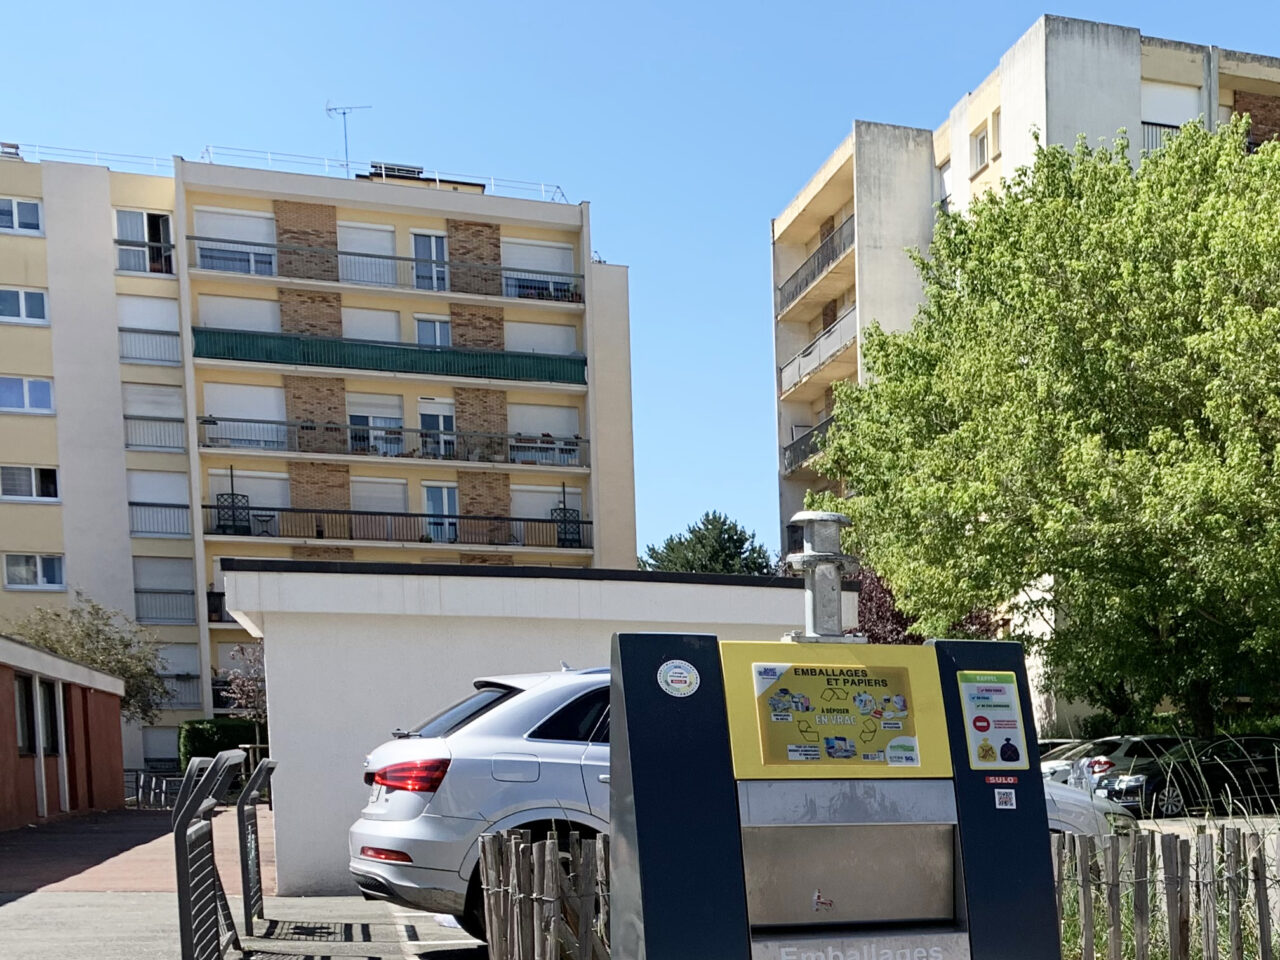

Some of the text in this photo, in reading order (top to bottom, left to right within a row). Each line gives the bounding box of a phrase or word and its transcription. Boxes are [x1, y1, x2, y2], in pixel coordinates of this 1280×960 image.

[794, 668, 868, 678] EMBALLAGES
[826, 678, 888, 688] ET PAPIERS
[815, 714, 857, 726] EN VRAC
[988, 776, 1015, 784] SULO
